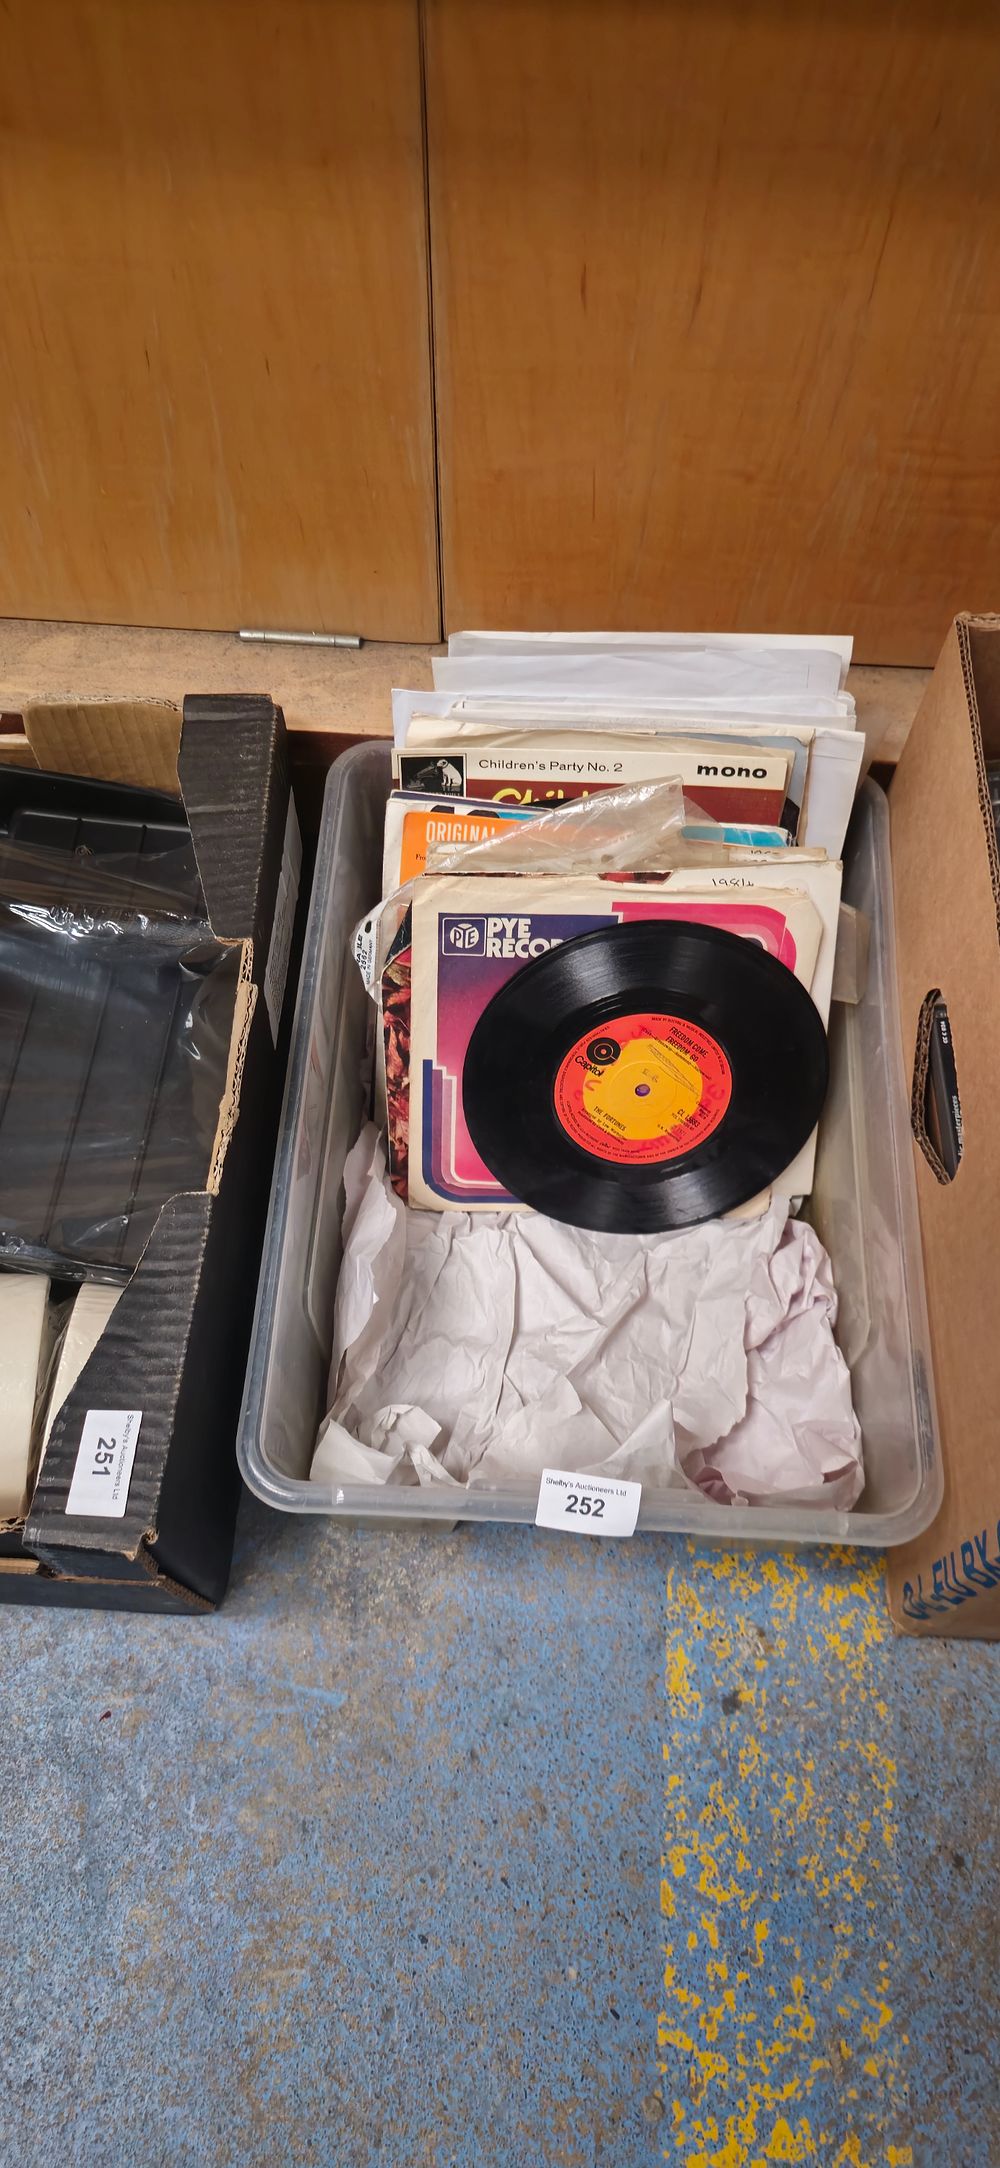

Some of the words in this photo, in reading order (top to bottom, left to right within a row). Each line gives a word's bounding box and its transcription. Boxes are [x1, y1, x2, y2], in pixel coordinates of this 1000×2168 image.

[478, 759, 546, 771] Children's
[549, 760, 584, 774] Party
[587, 761, 610, 772] No.
[613, 762, 623, 772] 2
[697, 764, 768, 779] mono
[425, 819, 496, 844] ORIGINA
[449, 923, 480, 949] PYE
[487, 917, 532, 939] PYE
[665, 1035, 690, 1055] FREEDOM
[669, 1026, 694, 1047] FREEDOM
[575, 1055, 605, 1077] Capitol
[92, 1437, 117, 1476] 251
[114, 1445, 128, 1487] Auctioneers
[545, 1476, 574, 1489] Shelby's
[574, 1482, 615, 1496] Auctioneers
[615, 1488, 627, 1497] Ltd
[564, 1494, 606, 1518] 252
